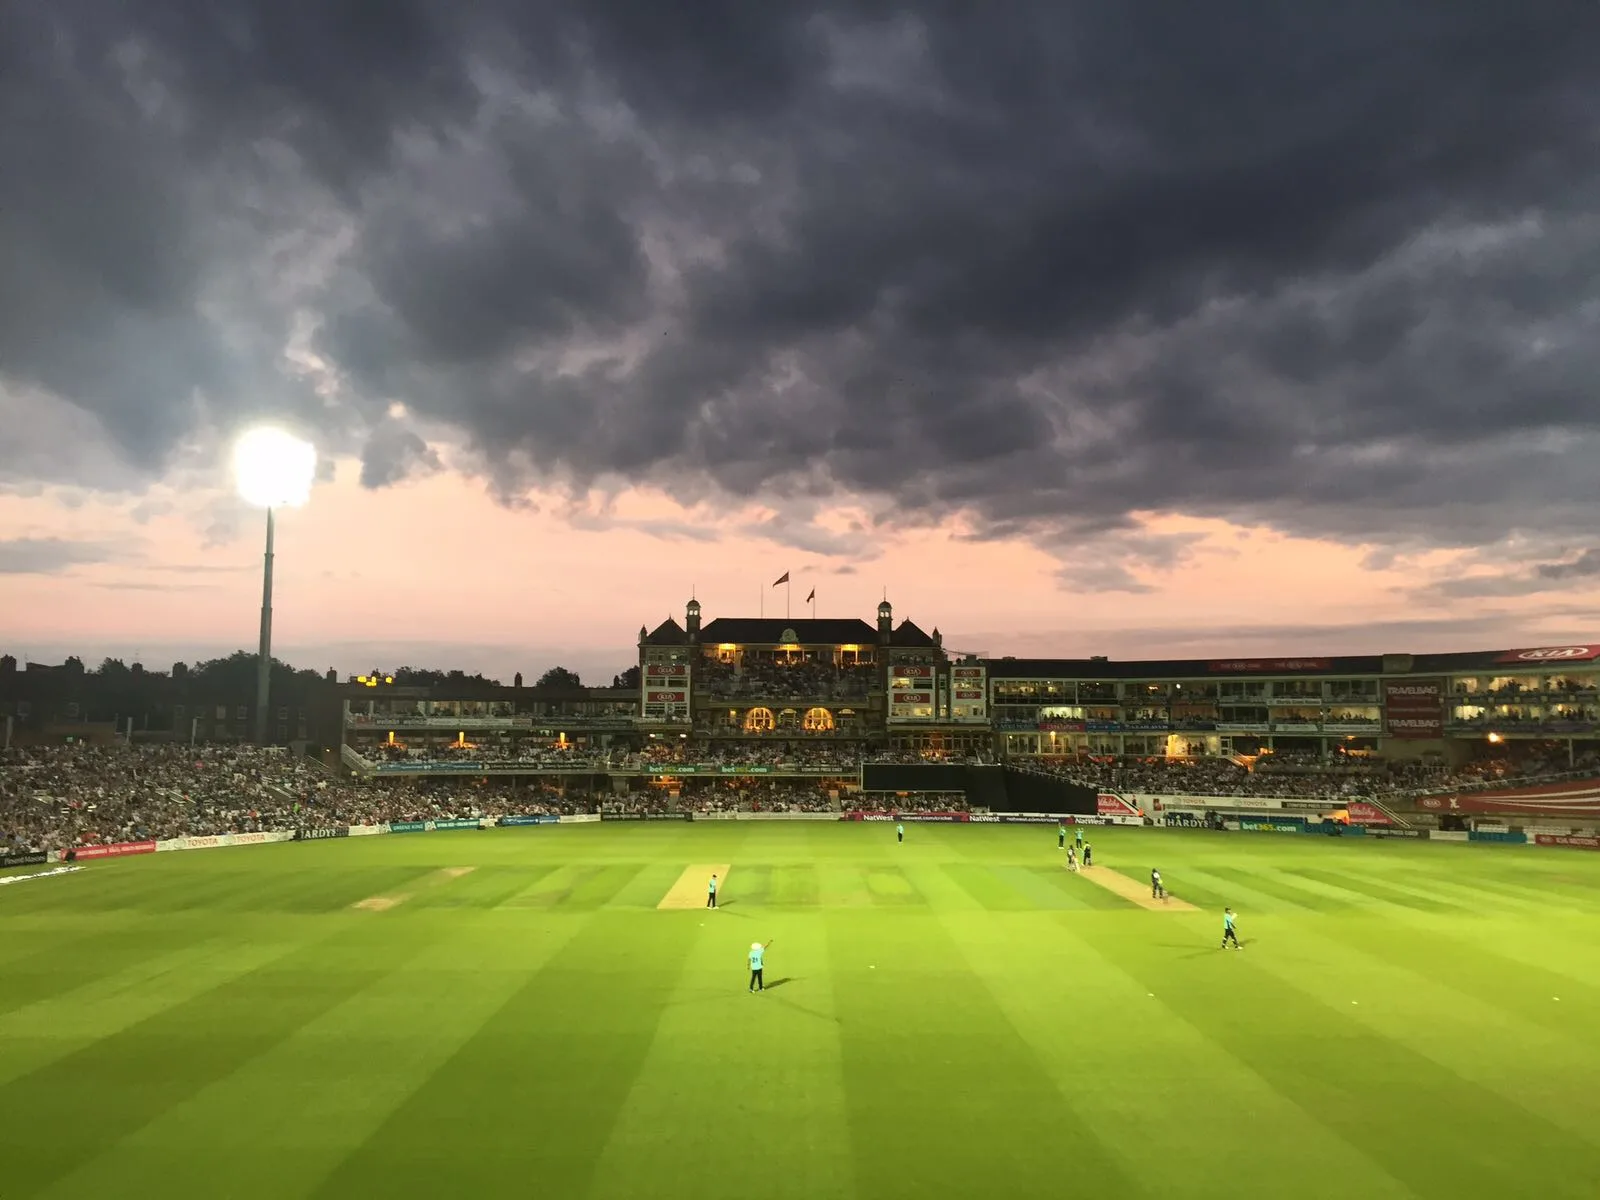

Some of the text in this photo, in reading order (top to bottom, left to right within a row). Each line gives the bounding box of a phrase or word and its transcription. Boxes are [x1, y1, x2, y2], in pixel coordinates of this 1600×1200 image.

[863, 814, 894, 822] NatWest
[969, 815, 1000, 823] NatWest
[1074, 817, 1106, 825] NatWest
[1166, 818, 1209, 829] HARDYS
[1242, 822, 1297, 832] bet365.com
[187, 837, 218, 847] TOYOTA
[237, 834, 266, 843] TOYOTA
